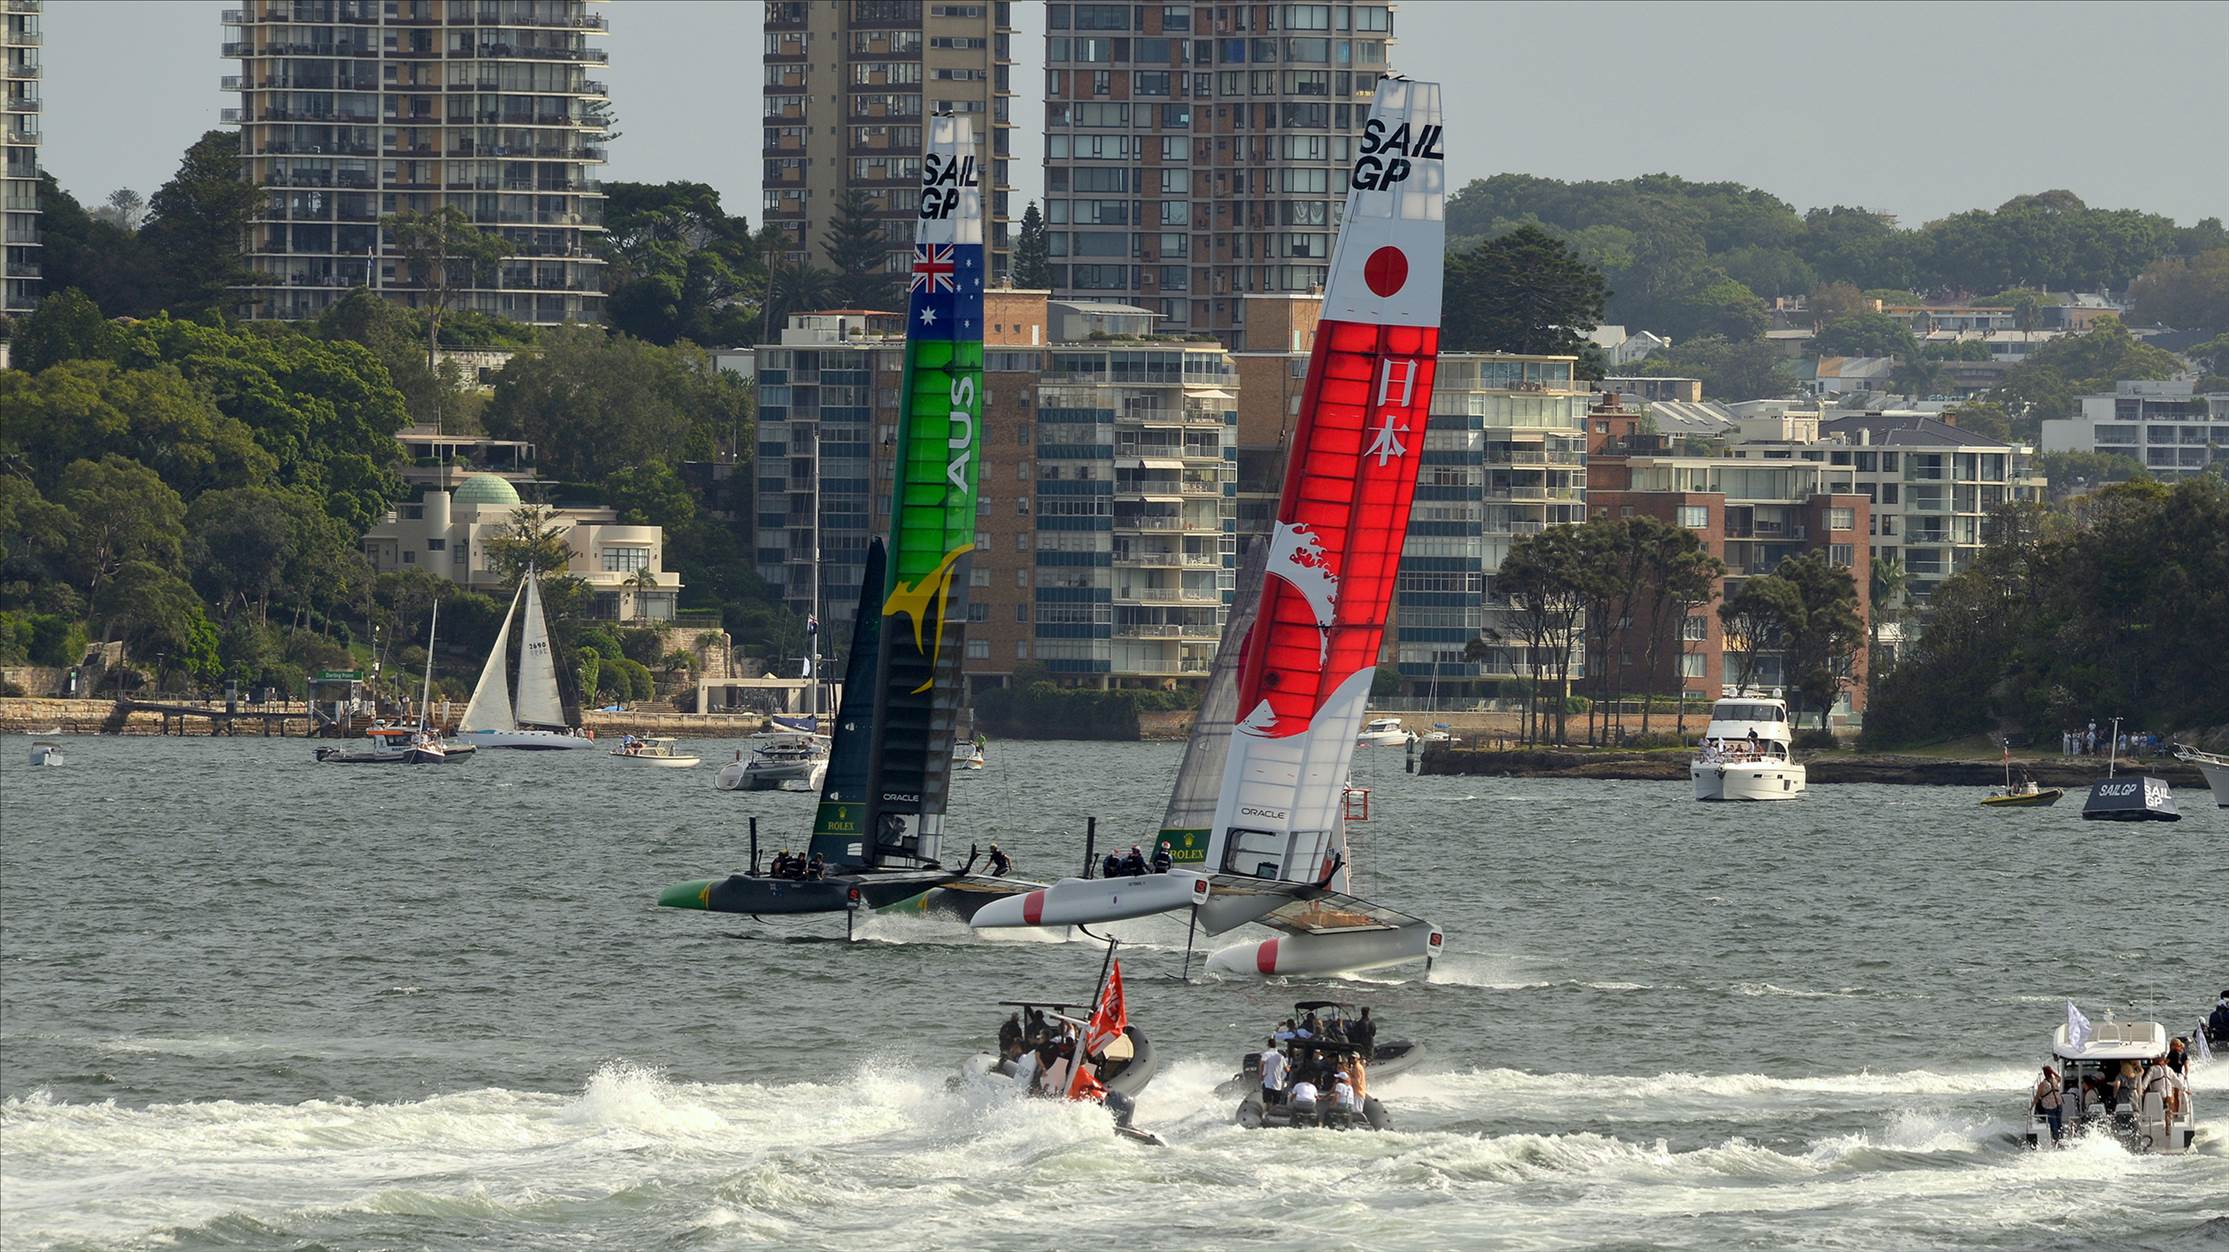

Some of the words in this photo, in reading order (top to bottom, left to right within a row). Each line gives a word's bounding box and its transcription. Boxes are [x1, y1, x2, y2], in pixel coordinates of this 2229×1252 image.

[1359, 119, 1444, 160] SAIL
[922, 153, 979, 187] SAIL
[1351, 155, 1411, 191] GP
[919, 187, 960, 219] GP
[1363, 358, 1418, 467] 日本
[947, 376, 975, 495] AUS
[882, 793, 919, 802] ORACLE
[2144, 784, 2172, 799] SAIL
[2145, 796, 2163, 807] GP
[1241, 807, 1286, 820] ORACLE
[827, 821, 855, 831] ROLEX
[1170, 849, 1204, 860] ROLEX
